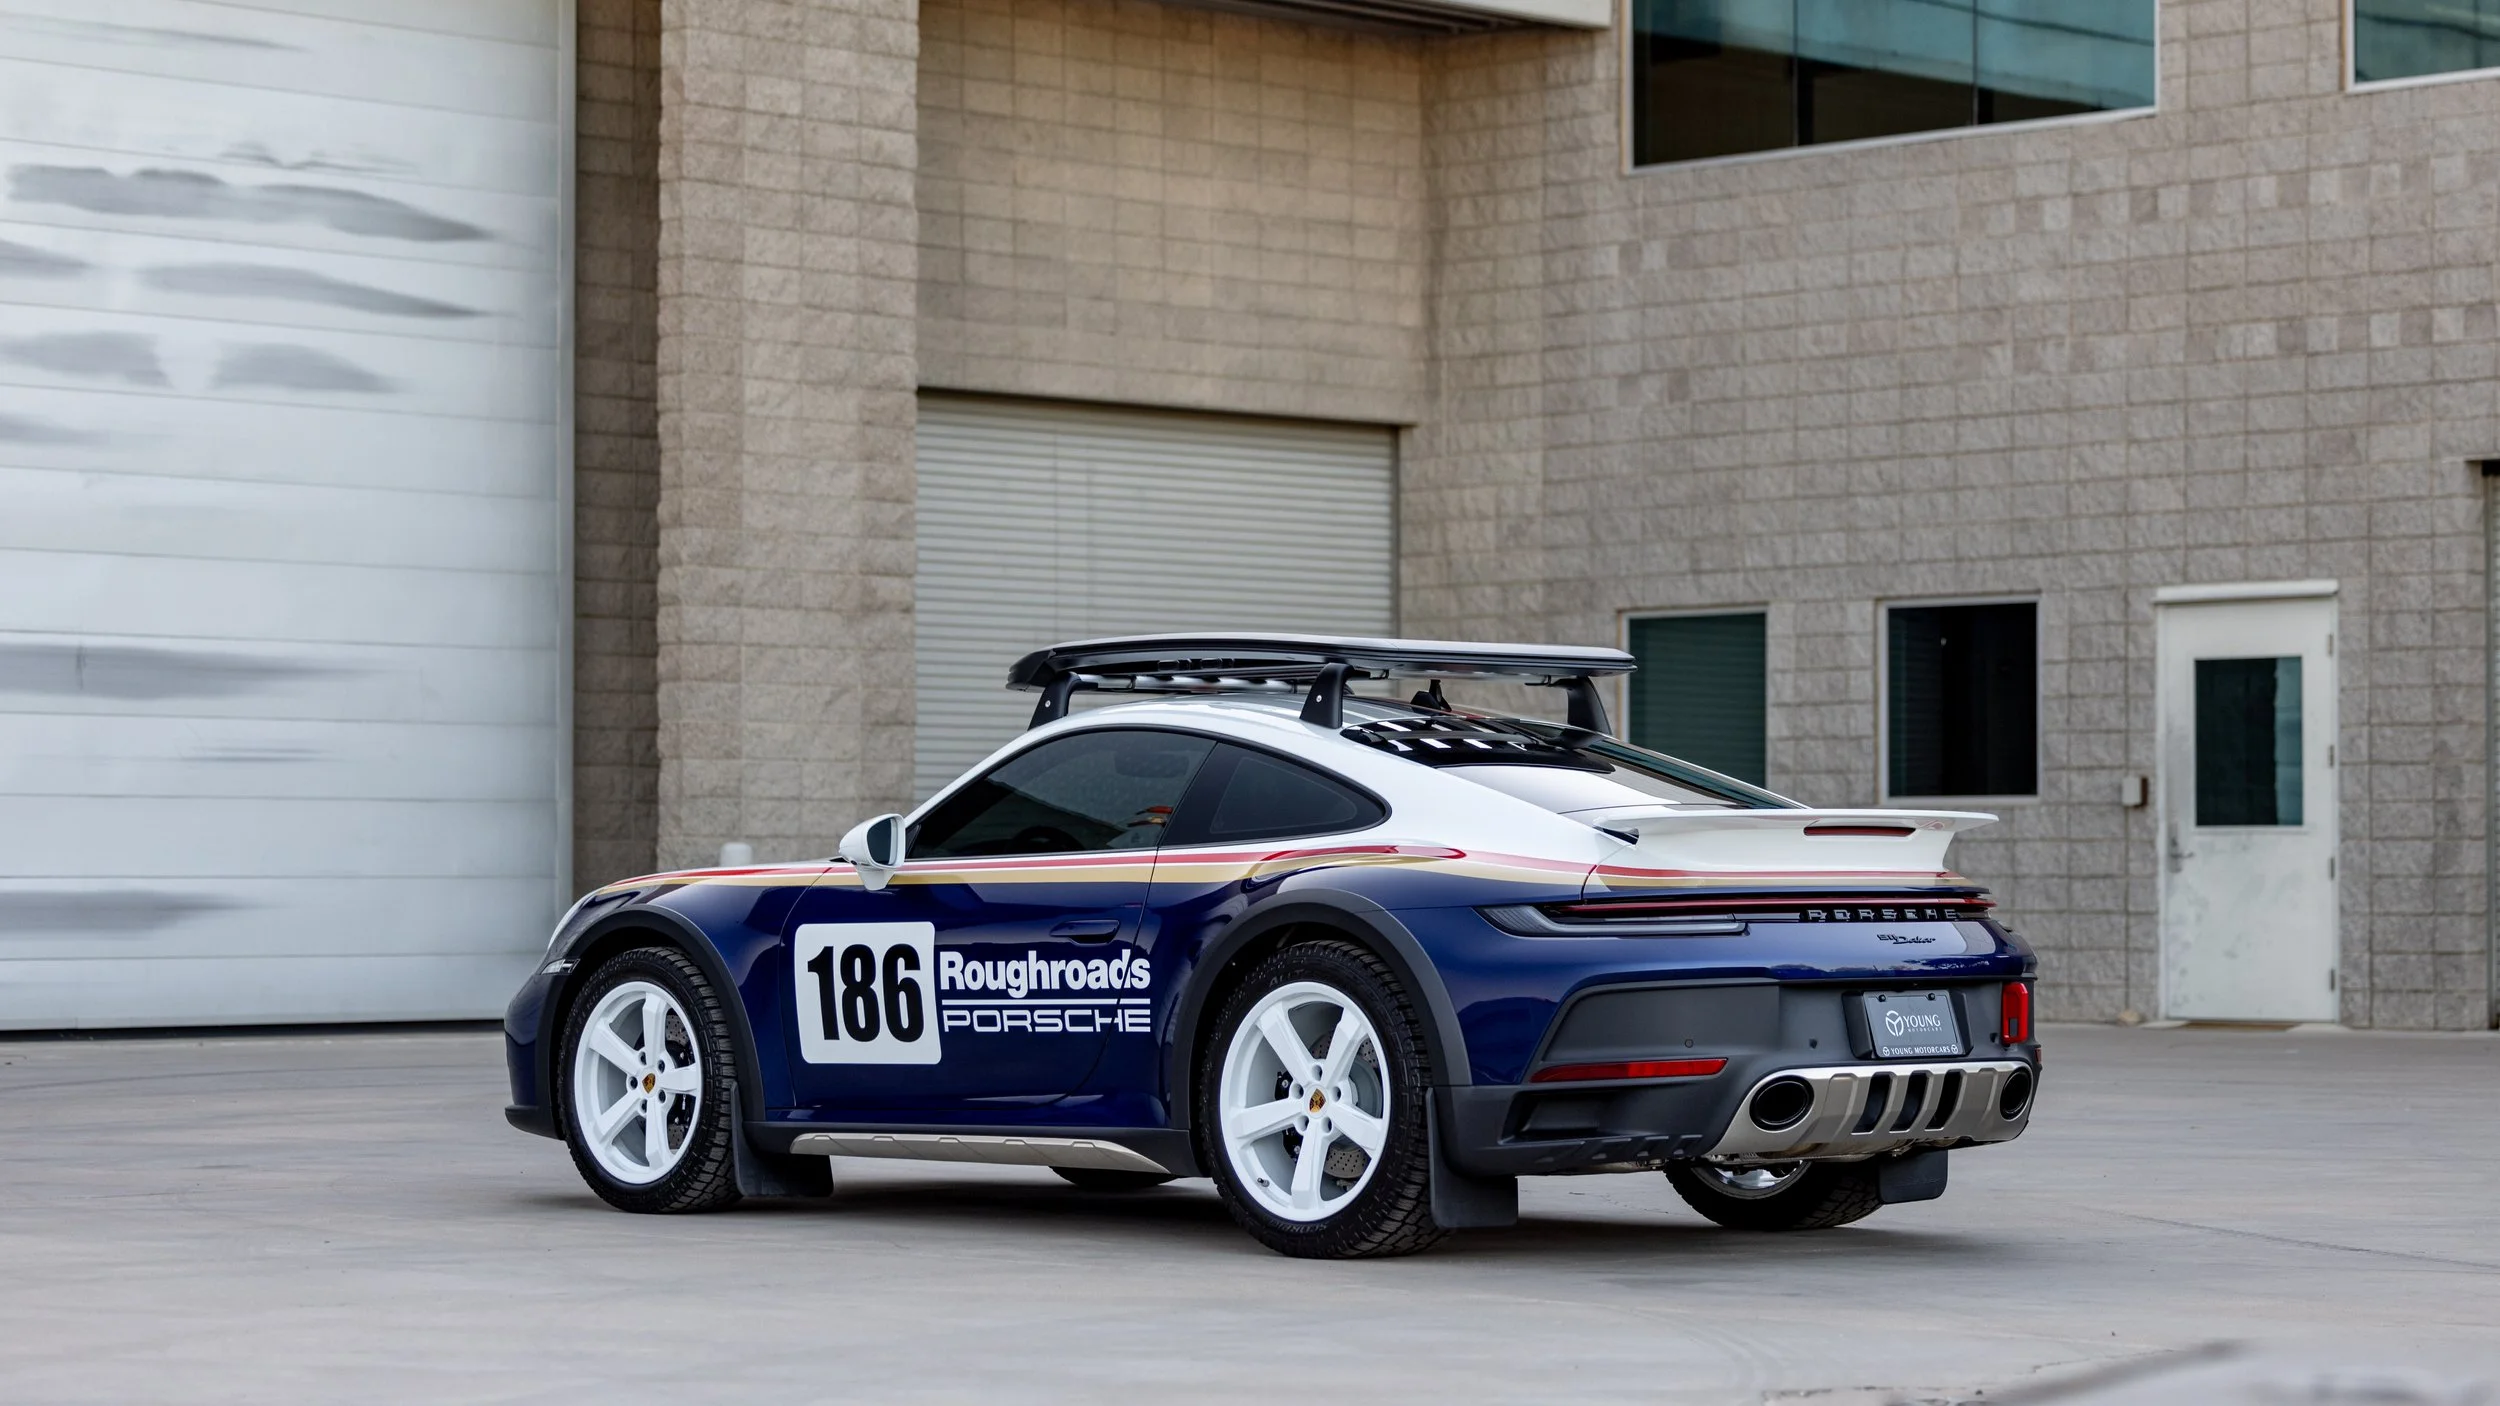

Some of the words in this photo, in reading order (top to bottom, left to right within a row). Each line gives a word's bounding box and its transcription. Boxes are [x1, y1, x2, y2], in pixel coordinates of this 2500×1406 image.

[1807, 908, 1957, 921] PORSCHE
[939, 949, 1151, 998] Roughroads
[807, 943, 925, 1043] 186
[941, 1009, 1151, 1033] PORSCHE
[1903, 1014, 1941, 1028] YOUNG
[1890, 1047, 1914, 1055] YOUNG
[1914, 1046, 1951, 1055] MOTORCARS
